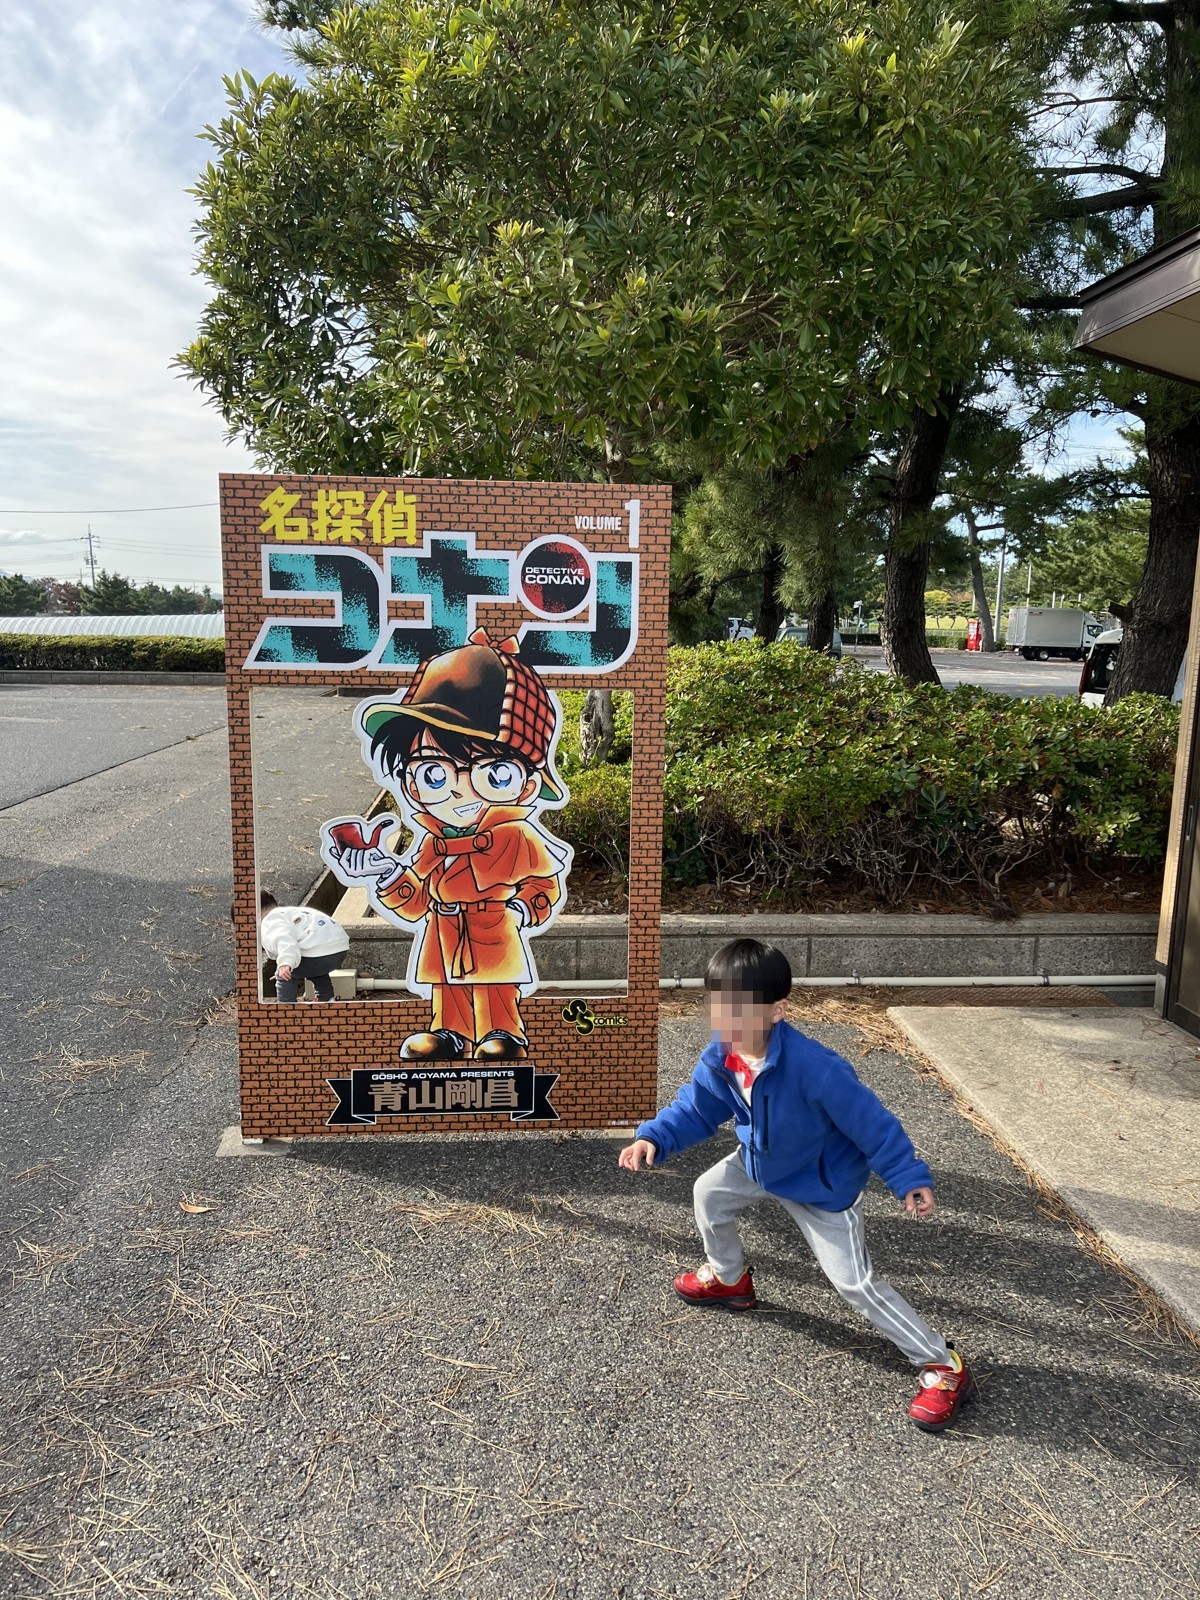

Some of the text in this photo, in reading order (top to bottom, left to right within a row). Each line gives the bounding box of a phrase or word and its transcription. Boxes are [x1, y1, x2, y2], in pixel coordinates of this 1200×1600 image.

[258, 485, 417, 545] 名探偵
[574, 499, 641, 549] VOLUME 1
[524, 574, 586, 585] CONAN
[525, 566, 585, 575] DETECTIVE
[241, 531, 641, 674] コナン
[411, 1071, 458, 1079] AOYAMA
[460, 1070, 515, 1078] PRESENTS
[367, 1078, 520, 1112] 青山剛昌
